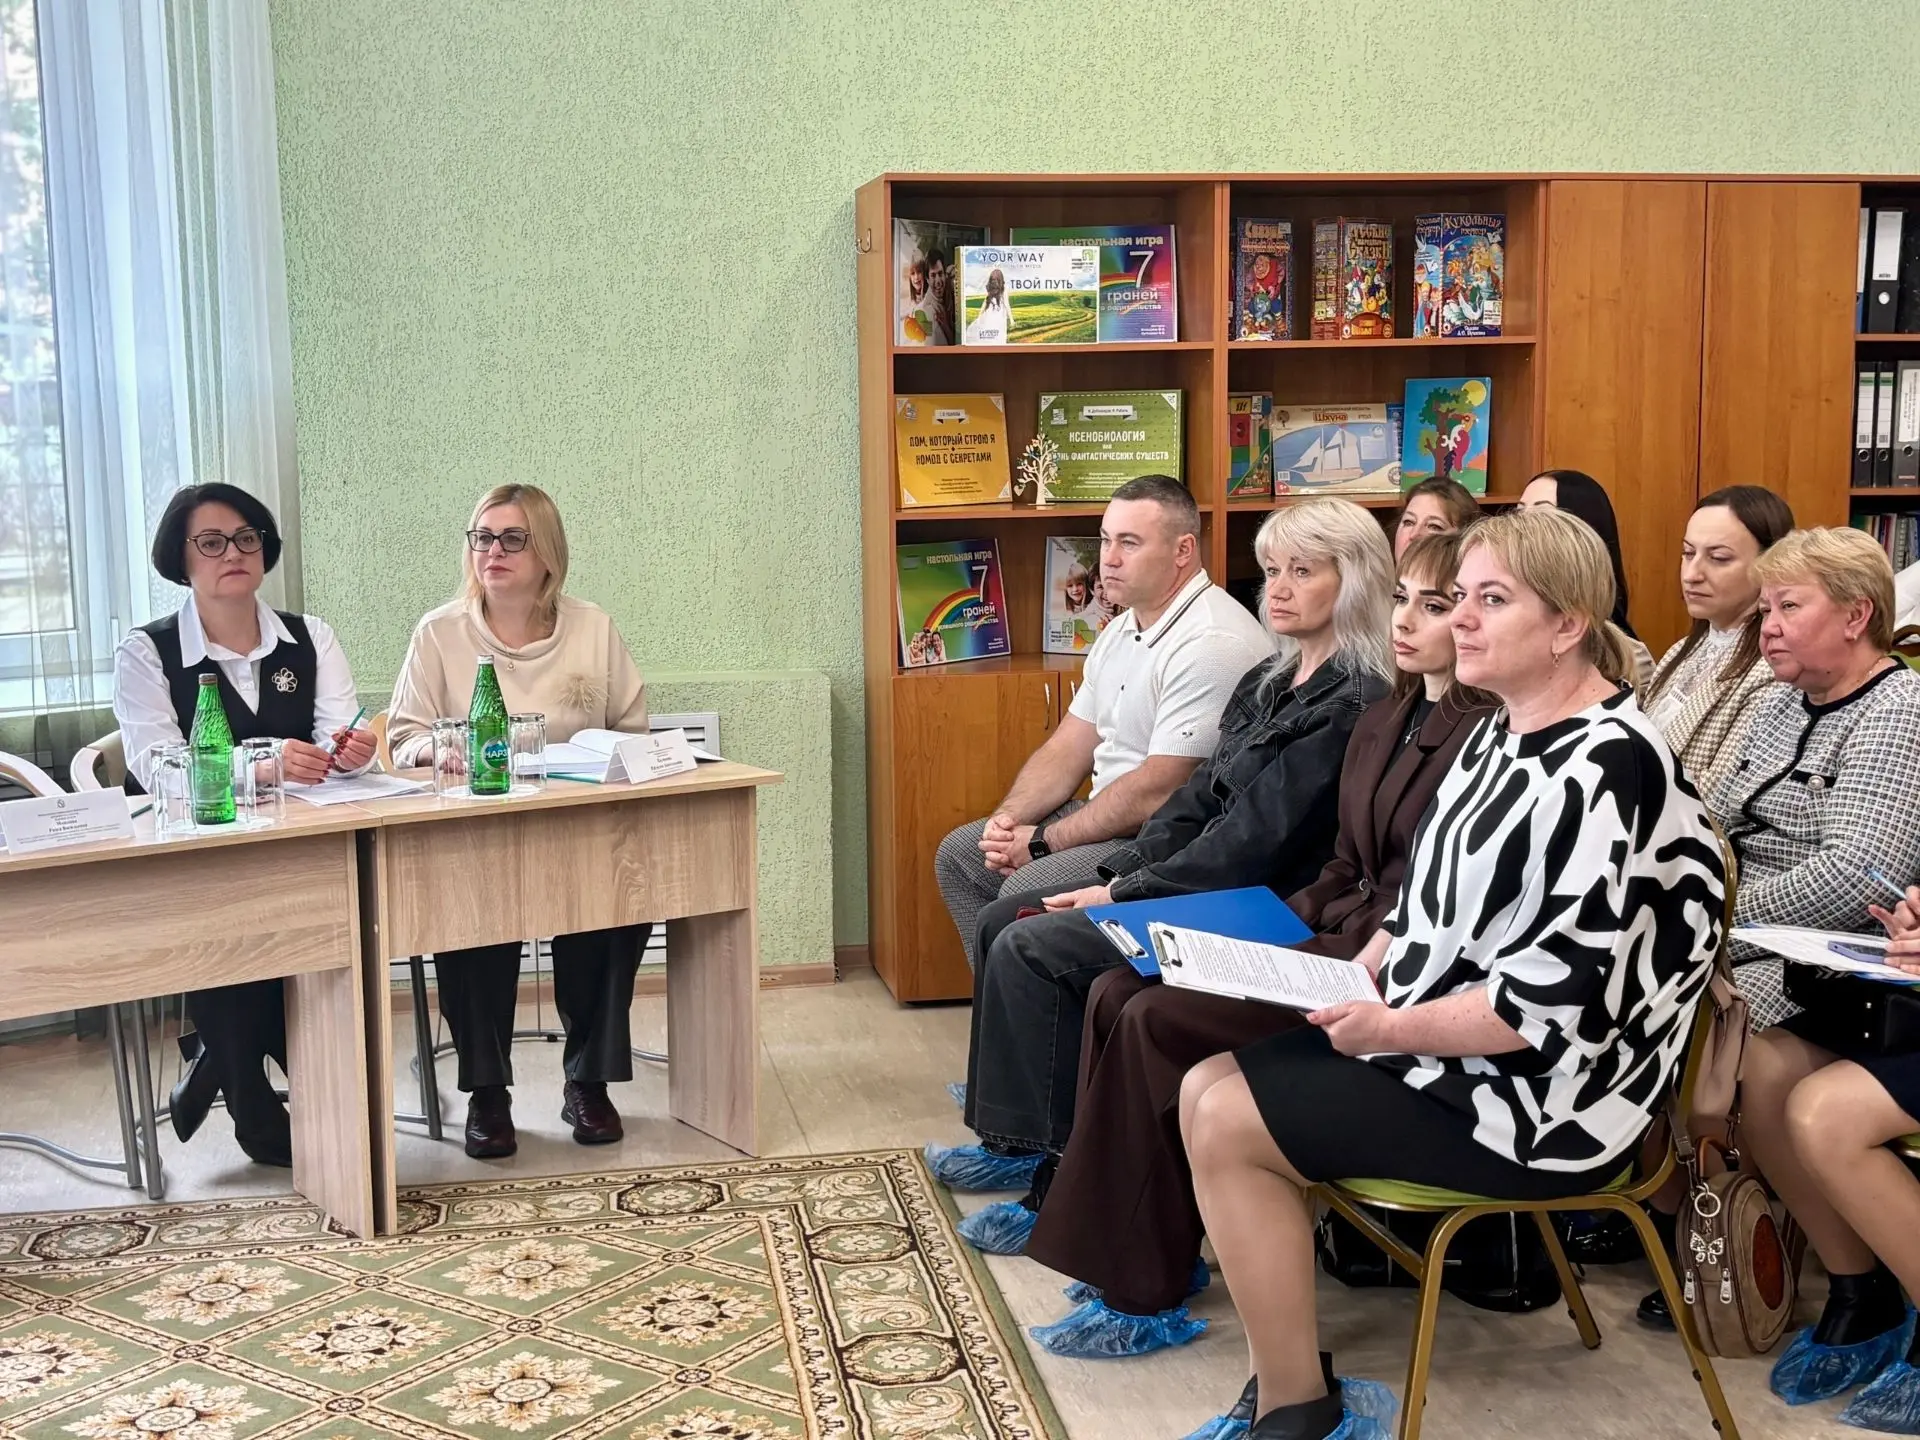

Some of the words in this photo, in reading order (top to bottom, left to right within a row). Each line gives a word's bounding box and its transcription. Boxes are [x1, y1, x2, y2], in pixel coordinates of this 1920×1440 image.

[1060, 237, 1132, 247] настольная
[1135, 236, 1164, 247] игра
[981, 252, 1013, 263] YOUR
[1017, 252, 1045, 263] WAY
[1129, 251, 1155, 288] 7
[1010, 277, 1041, 289] ТВОЙ
[1045, 279, 1073, 290] ПУТЬ
[1107, 287, 1158, 305] граней
[929, 432, 963, 446] КОТОРЫЙ
[964, 434, 989, 445] СТРОЮ
[990, 433, 996, 444] Я
[1069, 430, 1146, 443] КСЕНОБИОЛОГИЯ
[915, 453, 941, 466] КОМОД
[943, 453, 948, 465] С
[949, 452, 992, 465] СЕКРЕТАМИ
[1071, 451, 1134, 461] ФАНТАСТИЧЕСКИХ
[1136, 451, 1169, 460] СУЩЕСТВ
[926, 551, 973, 565] настольная
[974, 550, 993, 563] игра
[972, 564, 988, 603] 7
[962, 601, 996, 619] граней
